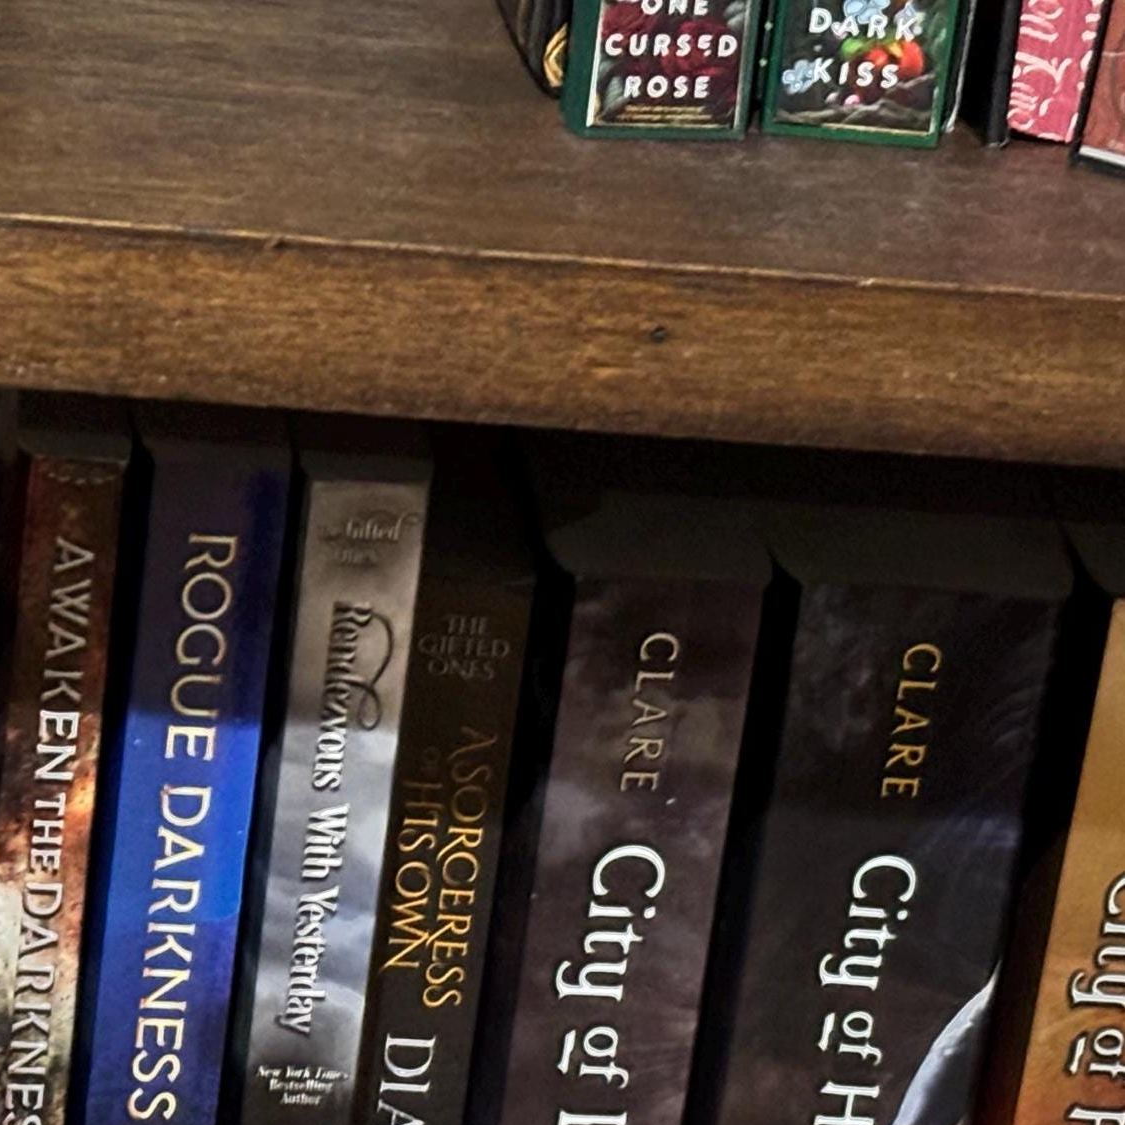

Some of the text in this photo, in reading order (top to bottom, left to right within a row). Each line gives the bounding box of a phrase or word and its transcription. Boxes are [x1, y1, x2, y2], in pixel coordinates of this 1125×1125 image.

[605, 33, 738, 57] CURSED
[641, 0, 709, 16] ONE
[809, 7, 917, 41] DARK
[625, 75, 710, 98] ROSE
[813, 57, 900, 89] KISS
[34, 536, 96, 781] AWAKEN
[312, 601, 393, 793] Rendezvous
[620, 632, 680, 792] CLARE
[879, 642, 943, 799] CLARE
[29, 792, 66, 875] THE
[127, 532, 239, 1120] ROGUE DARKNESS
[301, 803, 350, 880] With
[395, 780, 444, 852] HIS
[381, 861, 431, 973] OWN
[423, 762, 490, 1009] SORCERESS
[554, 844, 666, 1002] City
[818, 854, 917, 991] City
[276, 885, 340, 1037] Yesterday
[558, 1025, 629, 1090] of
[818, 1010, 882, 1066] of
